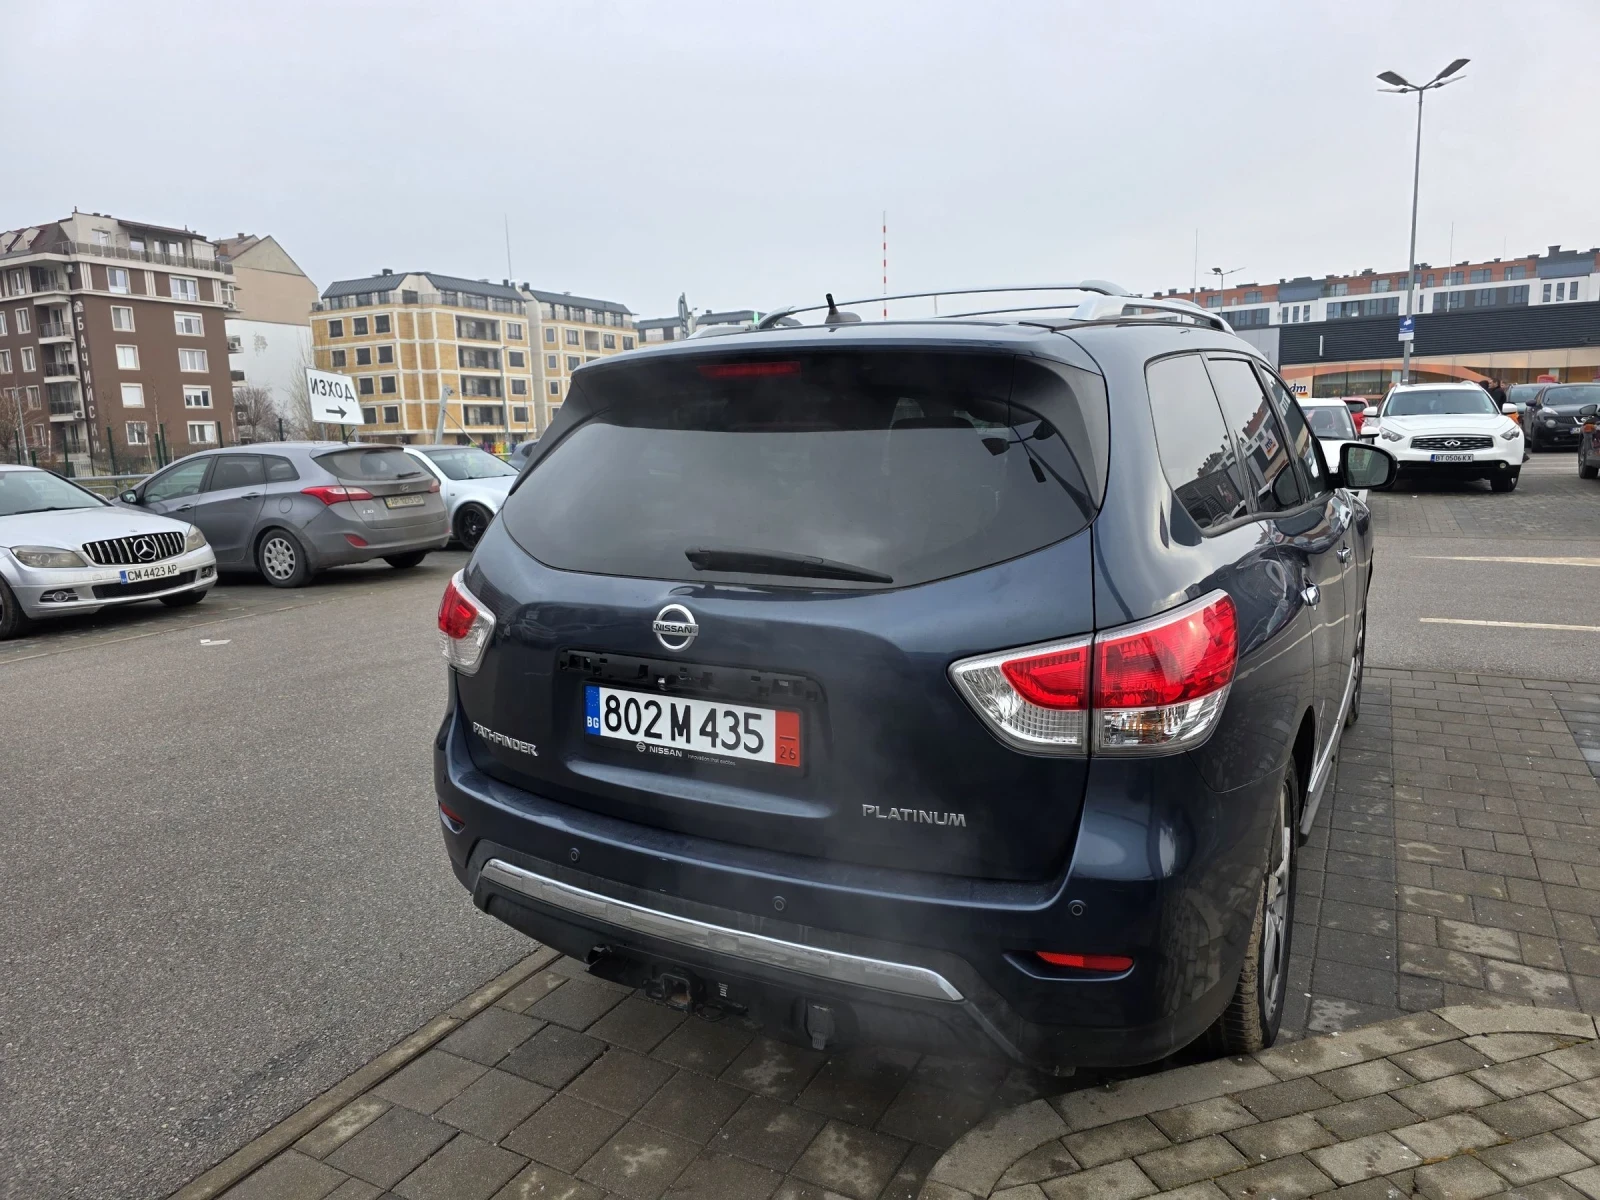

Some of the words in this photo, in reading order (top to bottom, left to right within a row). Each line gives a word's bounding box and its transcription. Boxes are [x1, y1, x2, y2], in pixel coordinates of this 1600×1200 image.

[77, 317, 100, 453] БАЧИЙСКИ
[310, 378, 355, 402] ИЗХОД
[1290, 383, 1307, 393] dm
[127, 570, 142, 581] CM
[143, 567, 166, 578] 4423
[167, 564, 177, 575] AP
[655, 623, 692, 634] NISSAN
[586, 715, 600, 729] BG
[604, 694, 663, 740] 802
[670, 702, 691, 744] M
[699, 707, 765, 755] 435
[472, 721, 539, 757] PATHFINDER
[649, 746, 683, 757] NISSAN
[779, 744, 797, 760] 26
[861, 803, 967, 828] PLATINUM
